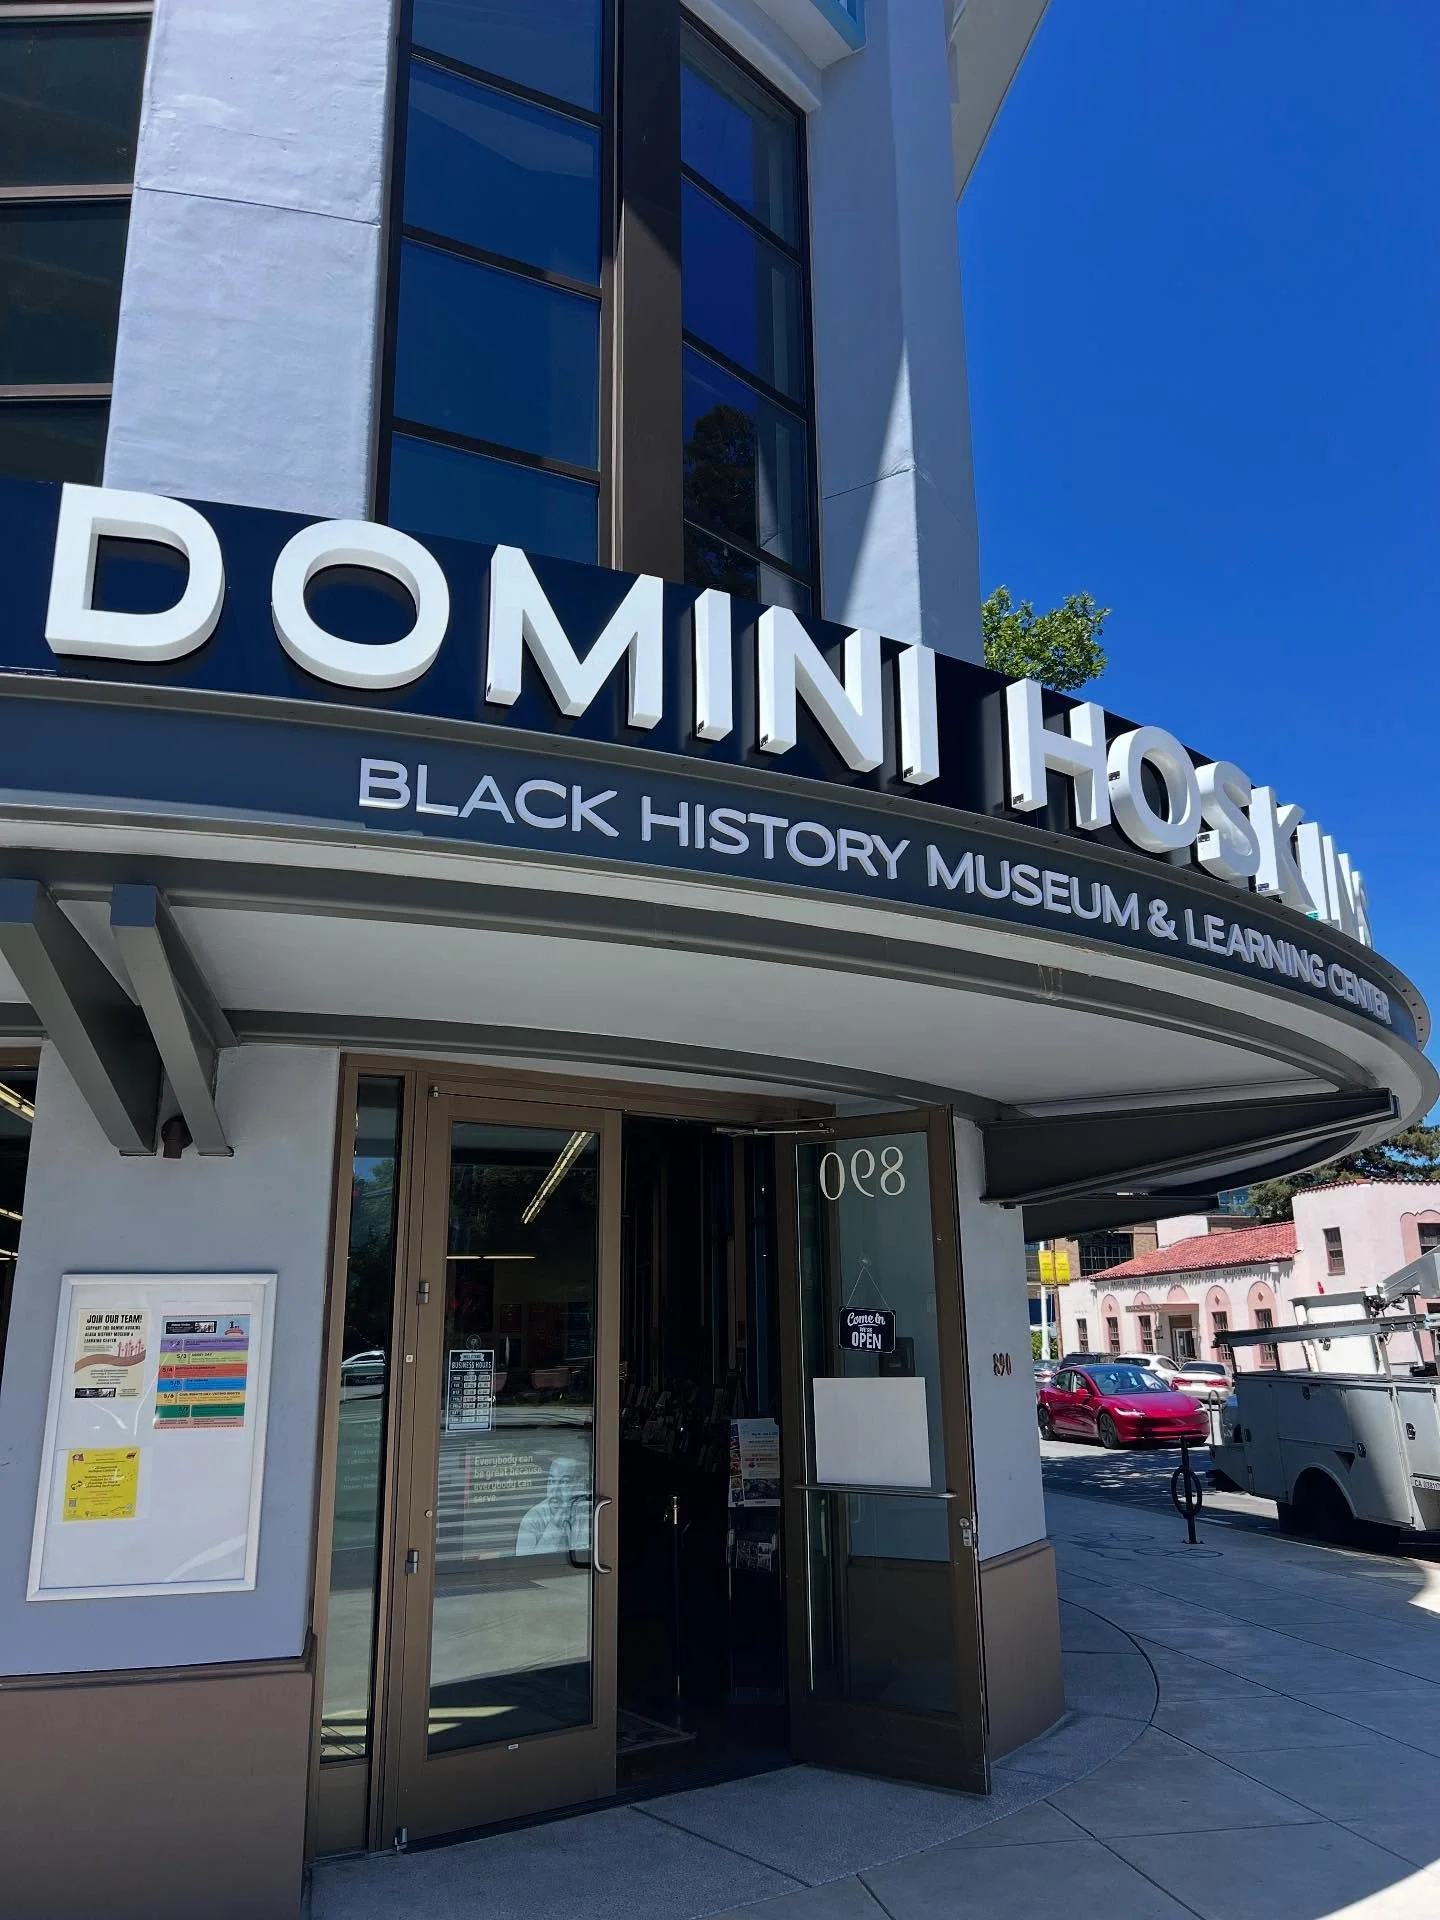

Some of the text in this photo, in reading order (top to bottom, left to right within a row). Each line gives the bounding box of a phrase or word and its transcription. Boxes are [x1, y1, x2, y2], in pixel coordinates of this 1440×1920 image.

[44, 482, 940, 786] DOMINI
[358, 757, 1393, 1025] BLACK HISTORY MUSEUM & LEARNING CENTER
[86, 1314, 143, 1323] JOIN OUR TEAM!
[847, 1312, 875, 1326] Come
[851, 1331, 882, 1350] OPEN
[451, 1361, 492, 1369] BUSINESS HOURS
[992, 1352, 1012, 1376] 890
[474, 1455, 534, 1467] Everybody can
[474, 1465, 542, 1480] be great because
[473, 1479, 533, 1492] everybody can
